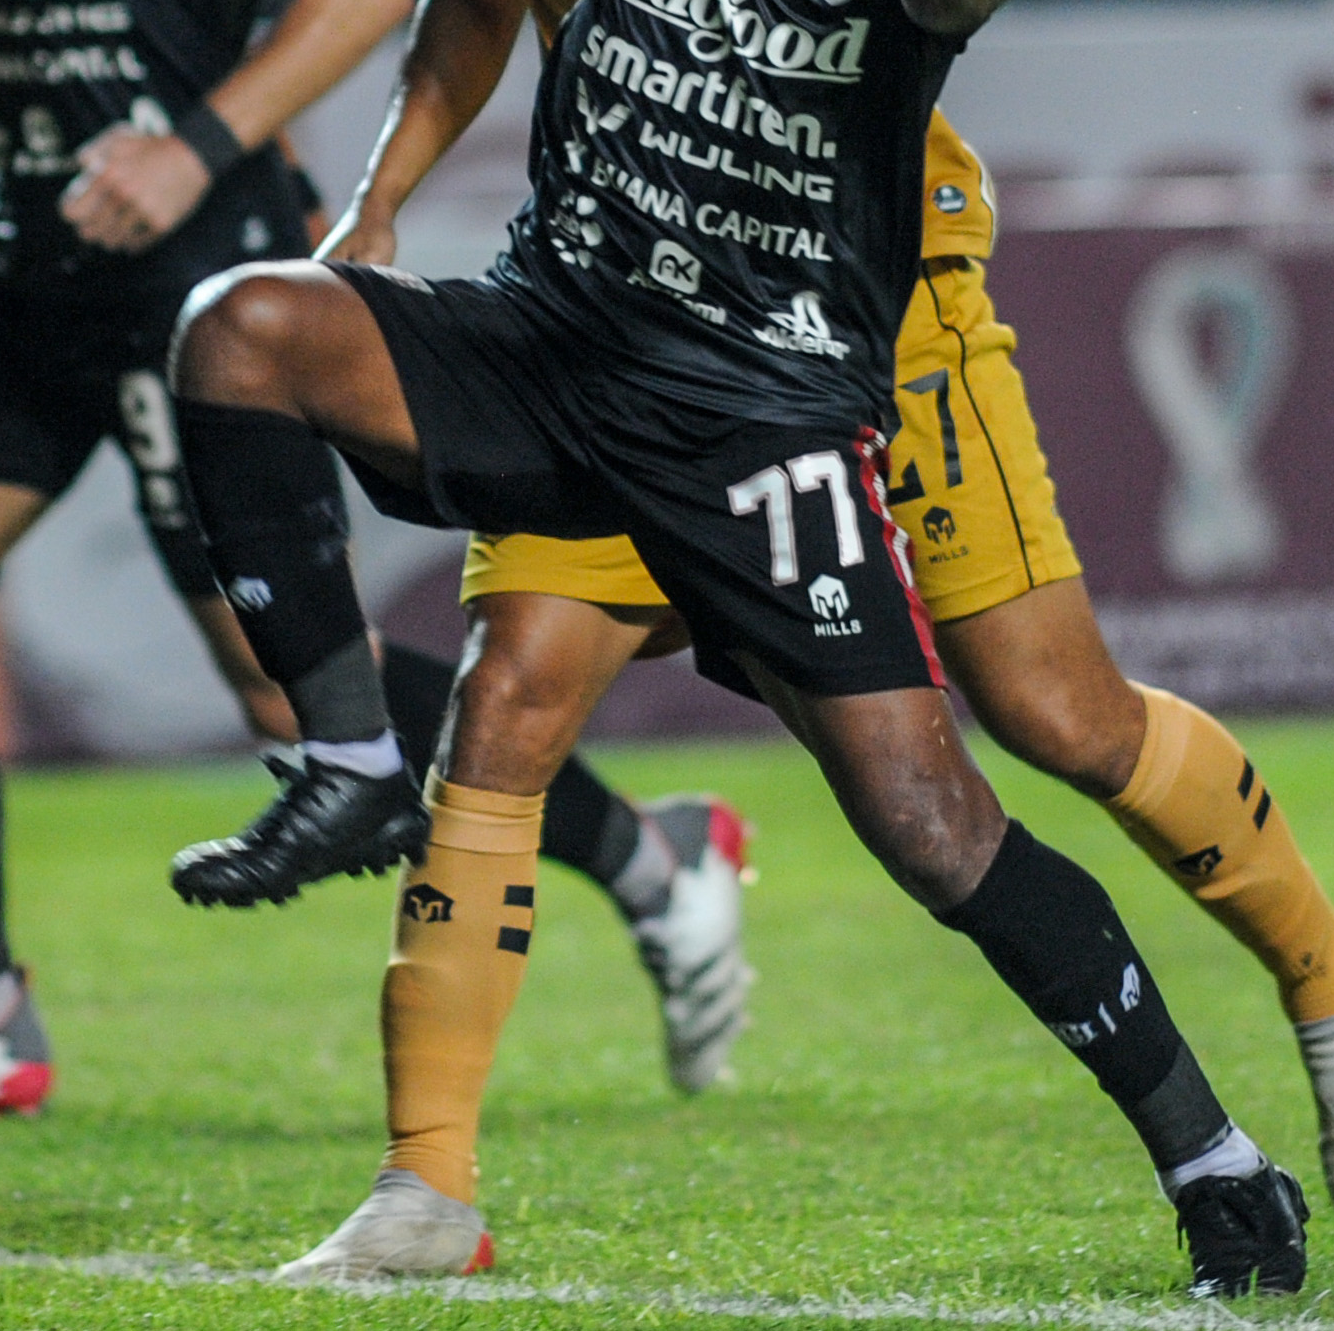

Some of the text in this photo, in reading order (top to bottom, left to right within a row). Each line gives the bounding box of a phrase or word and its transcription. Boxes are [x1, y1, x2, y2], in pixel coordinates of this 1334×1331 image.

[639, 120, 835, 203] WULING
[695, 203, 833, 263] CAPITAL
[119, 370, 178, 469] 9
[726, 449, 865, 587] 77
[814, 618, 863, 638] MILLS
